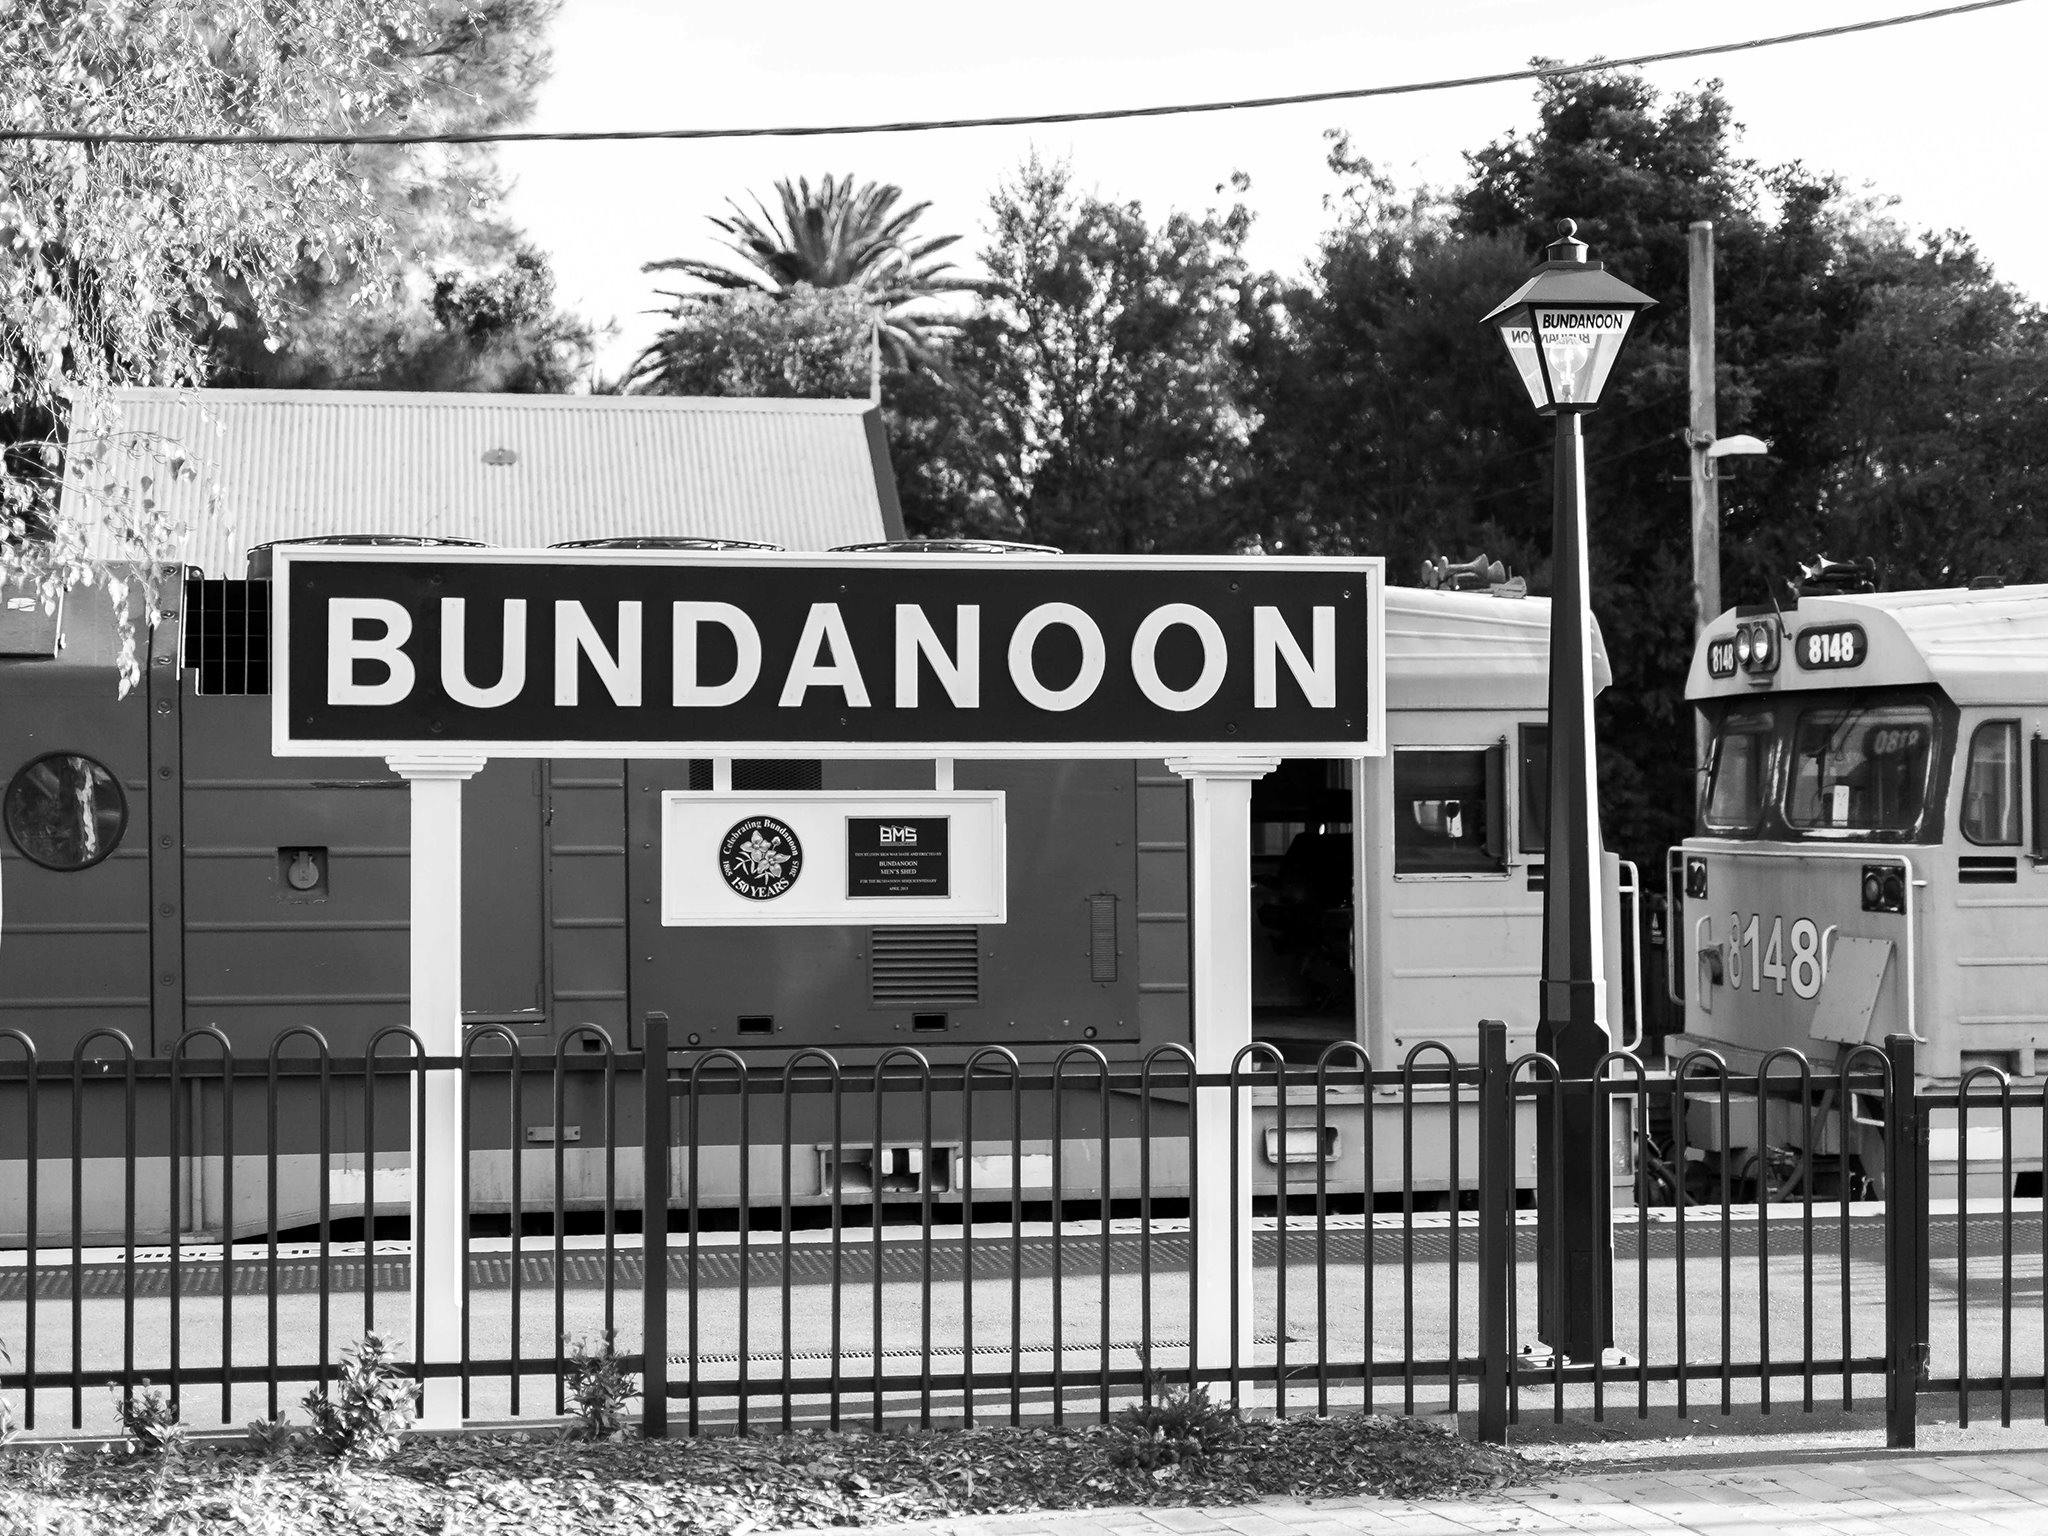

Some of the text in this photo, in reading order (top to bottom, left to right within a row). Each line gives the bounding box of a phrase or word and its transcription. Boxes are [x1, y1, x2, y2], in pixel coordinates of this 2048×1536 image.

[1543, 313, 1623, 329] BUNDANOON
[326, 596, 1338, 713] BUNDANOON
[1712, 643, 1734, 672] 8148
[1808, 631, 1854, 664] 8148
[723, 819, 798, 856] Celebrating Bundanoon
[880, 825, 917, 842] BMS
[731, 876, 790, 898] 150 YEARS
[1729, 911, 1822, 1000] 8148
